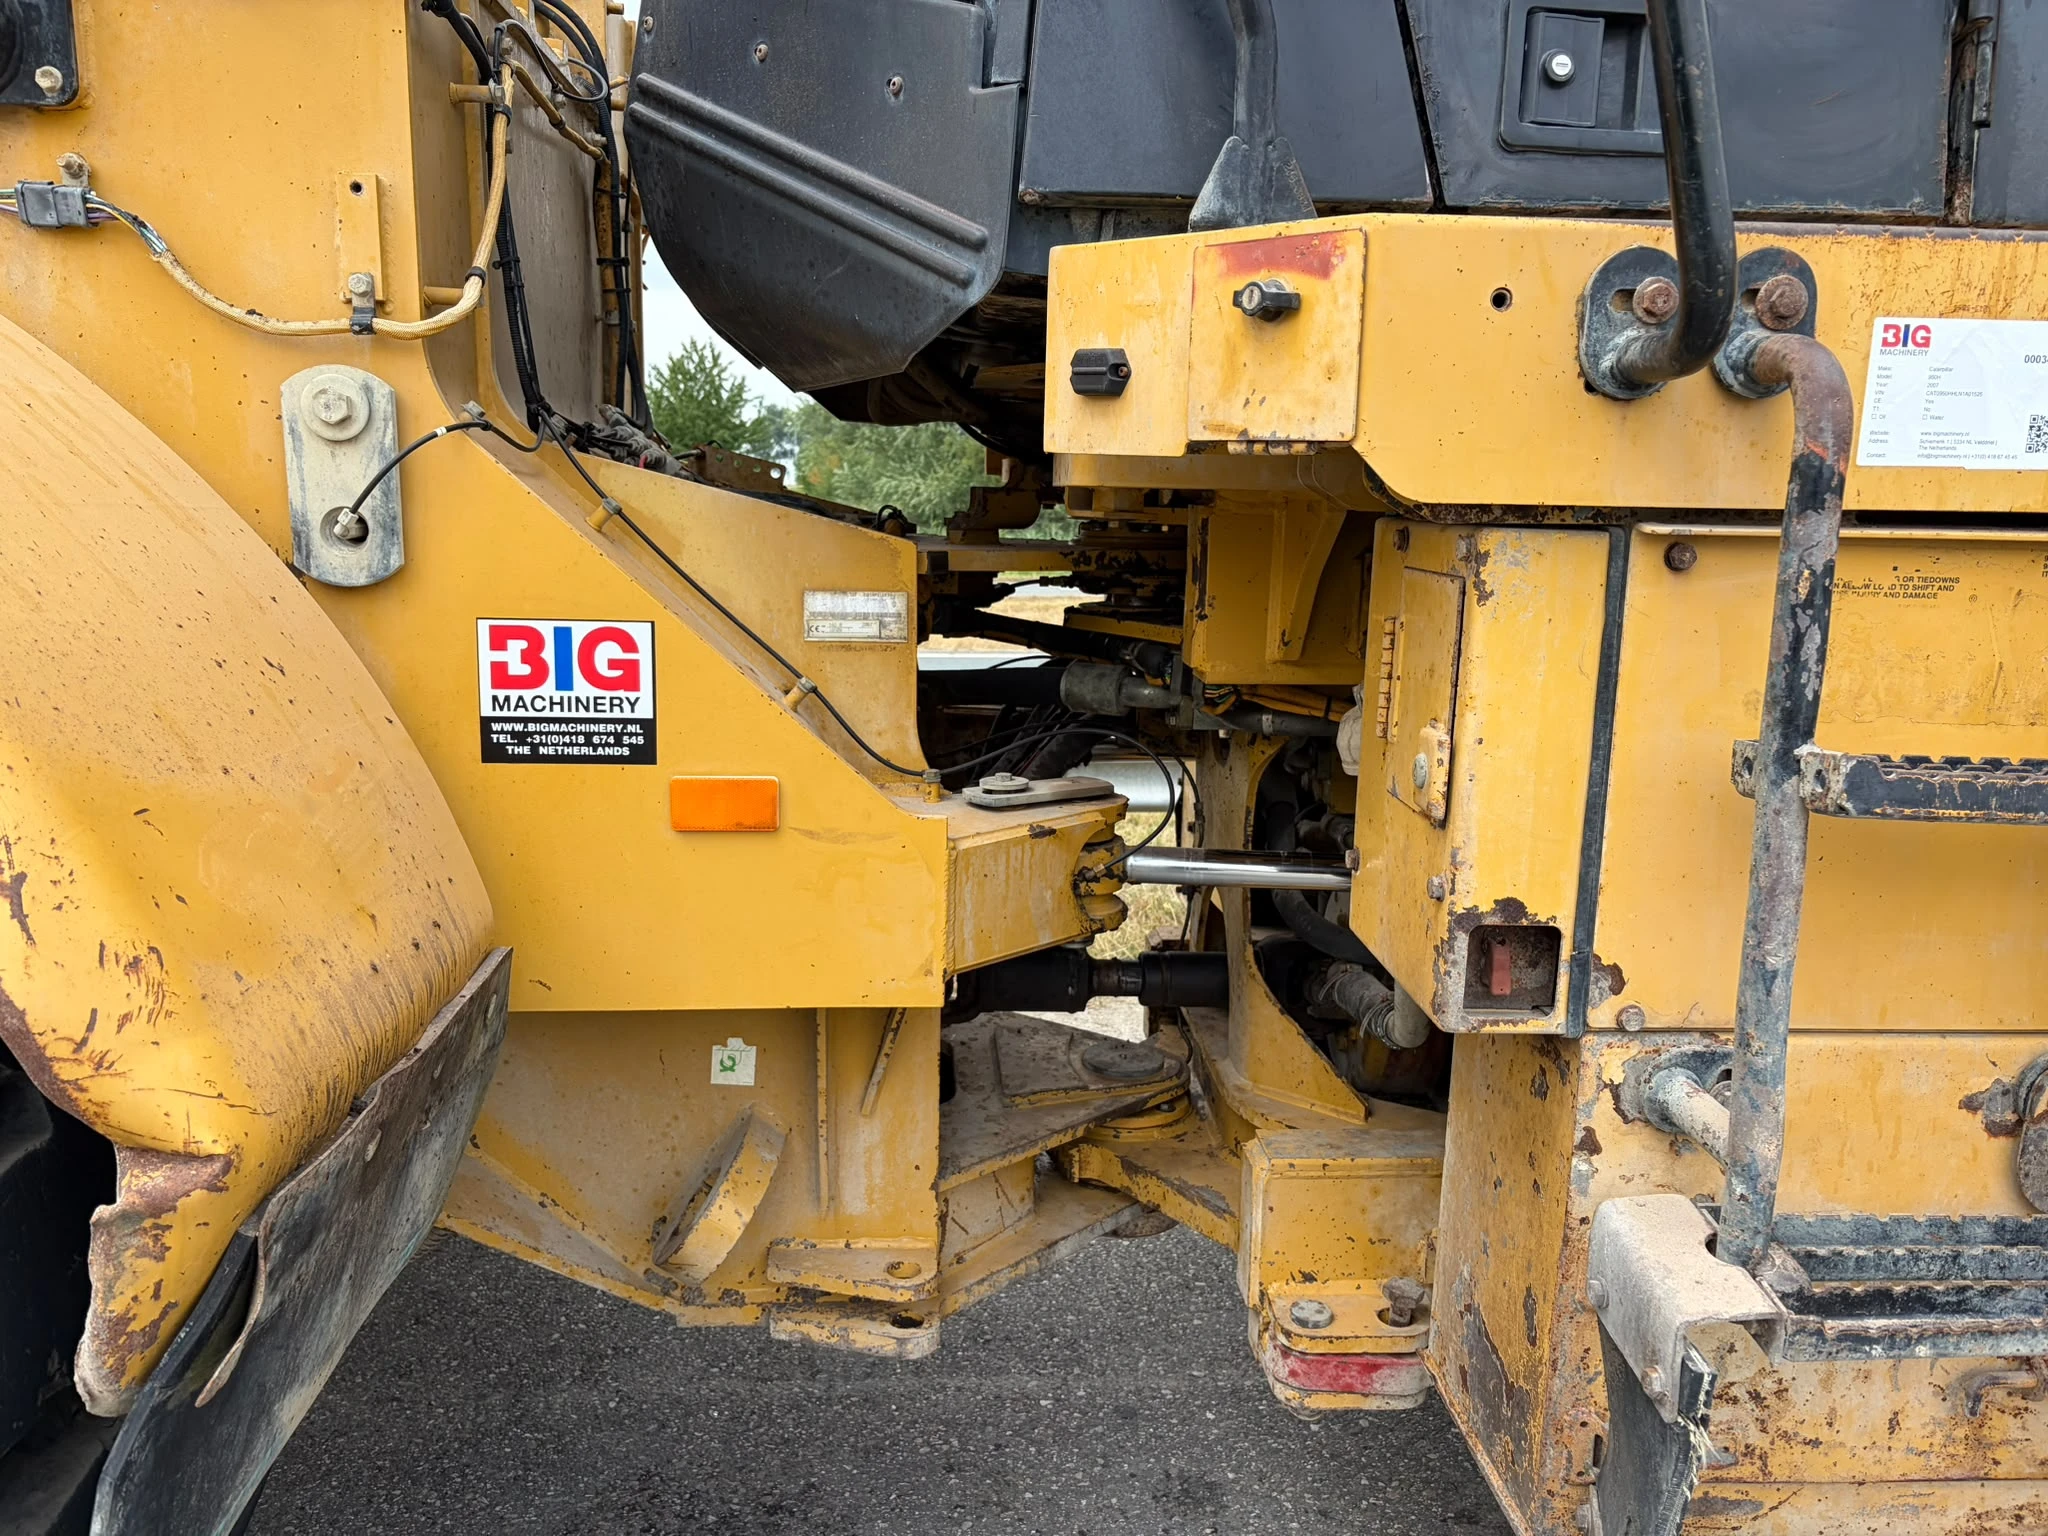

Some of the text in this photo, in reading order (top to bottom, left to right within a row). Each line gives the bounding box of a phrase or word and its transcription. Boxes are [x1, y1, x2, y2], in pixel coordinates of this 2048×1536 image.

[1881, 323, 1931, 348] BIG
[1880, 348, 1930, 356] MACHINERY
[2024, 354, 2048, 364] 0003
[1902, 575, 1915, 583] OR
[1917, 576, 1960, 584] TIEDOWNS
[1899, 583, 1910, 591] TO
[1912, 584, 1935, 592] SHIFT
[1937, 584, 1955, 592] AND
[1883, 591, 1901, 599] AND
[489, 624, 641, 692] BIG
[491, 694, 641, 714] MACHINERY
[490, 722, 644, 733] WWW.BIGMACHINERY.NL
[490, 734, 645, 745] TEL. +31(0)418 674 545
[506, 745, 631, 756] THE NETHERLANDS
